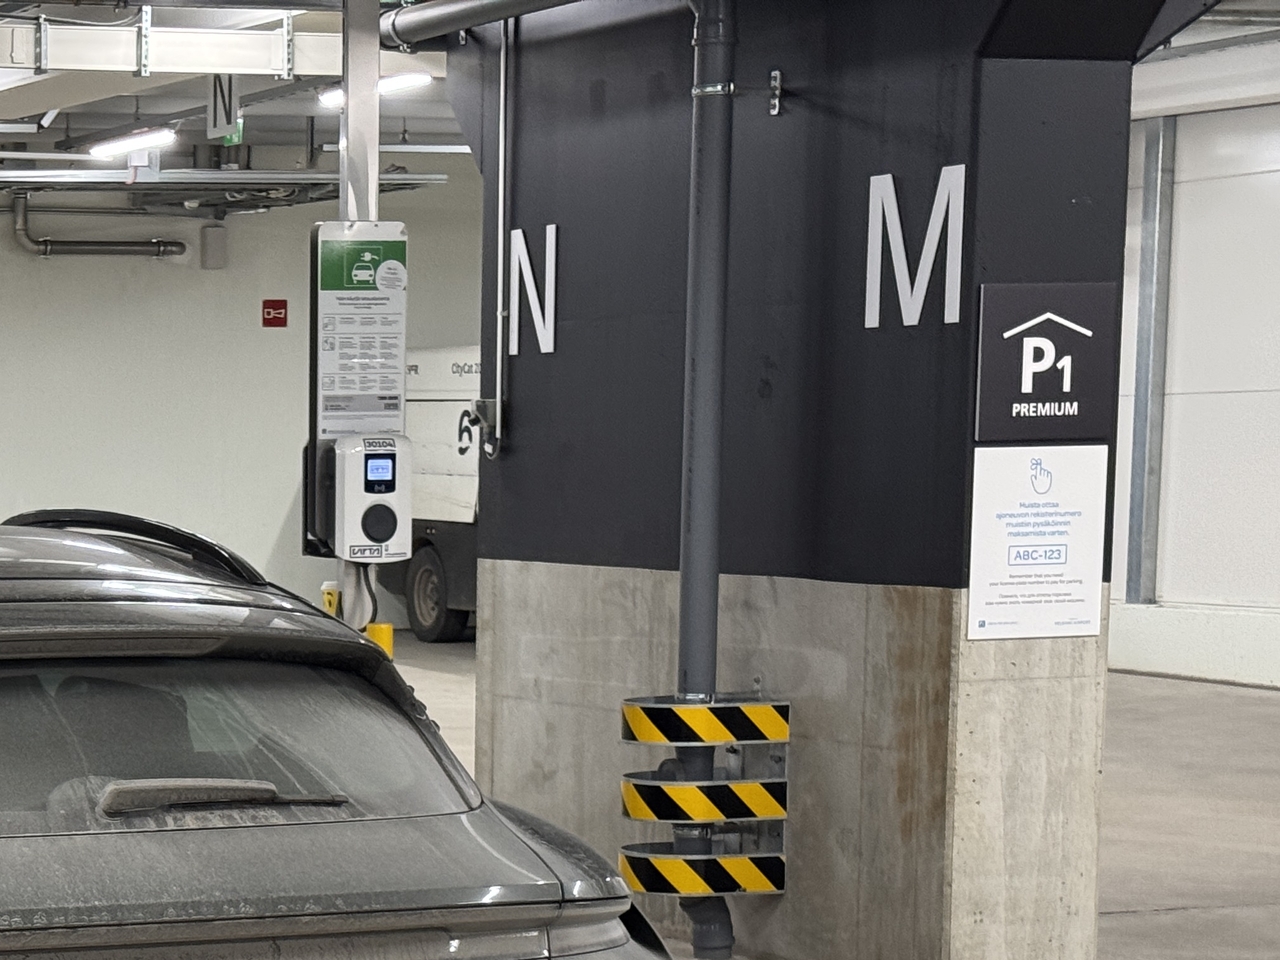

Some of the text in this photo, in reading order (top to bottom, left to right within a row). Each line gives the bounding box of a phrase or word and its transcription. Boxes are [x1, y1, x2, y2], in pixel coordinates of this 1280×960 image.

[213, 74, 232, 129] N
[864, 164, 966, 329] M
[508, 223, 557, 356] N
[1021, 336, 1072, 394] P1
[1012, 401, 1079, 417] PREMIUM
[365, 440, 394, 448] 30104
[1014, 549, 1062, 561] ABC-123
